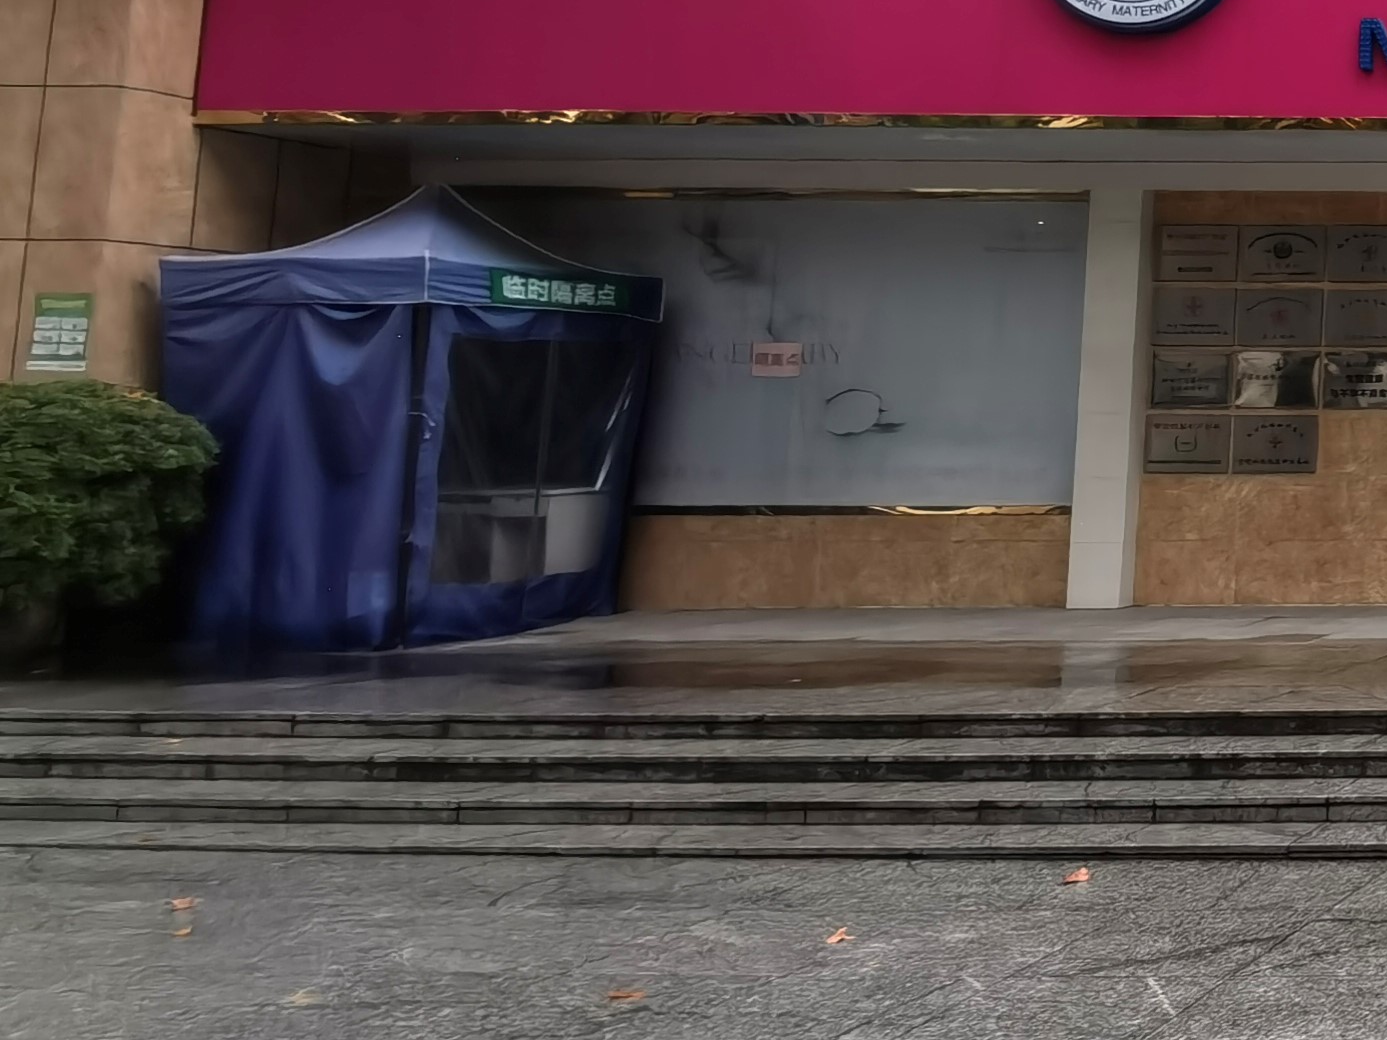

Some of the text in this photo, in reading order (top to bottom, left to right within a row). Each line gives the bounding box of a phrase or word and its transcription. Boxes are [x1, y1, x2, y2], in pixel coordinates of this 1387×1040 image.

[501, 274, 616, 307] 临时隔离点
